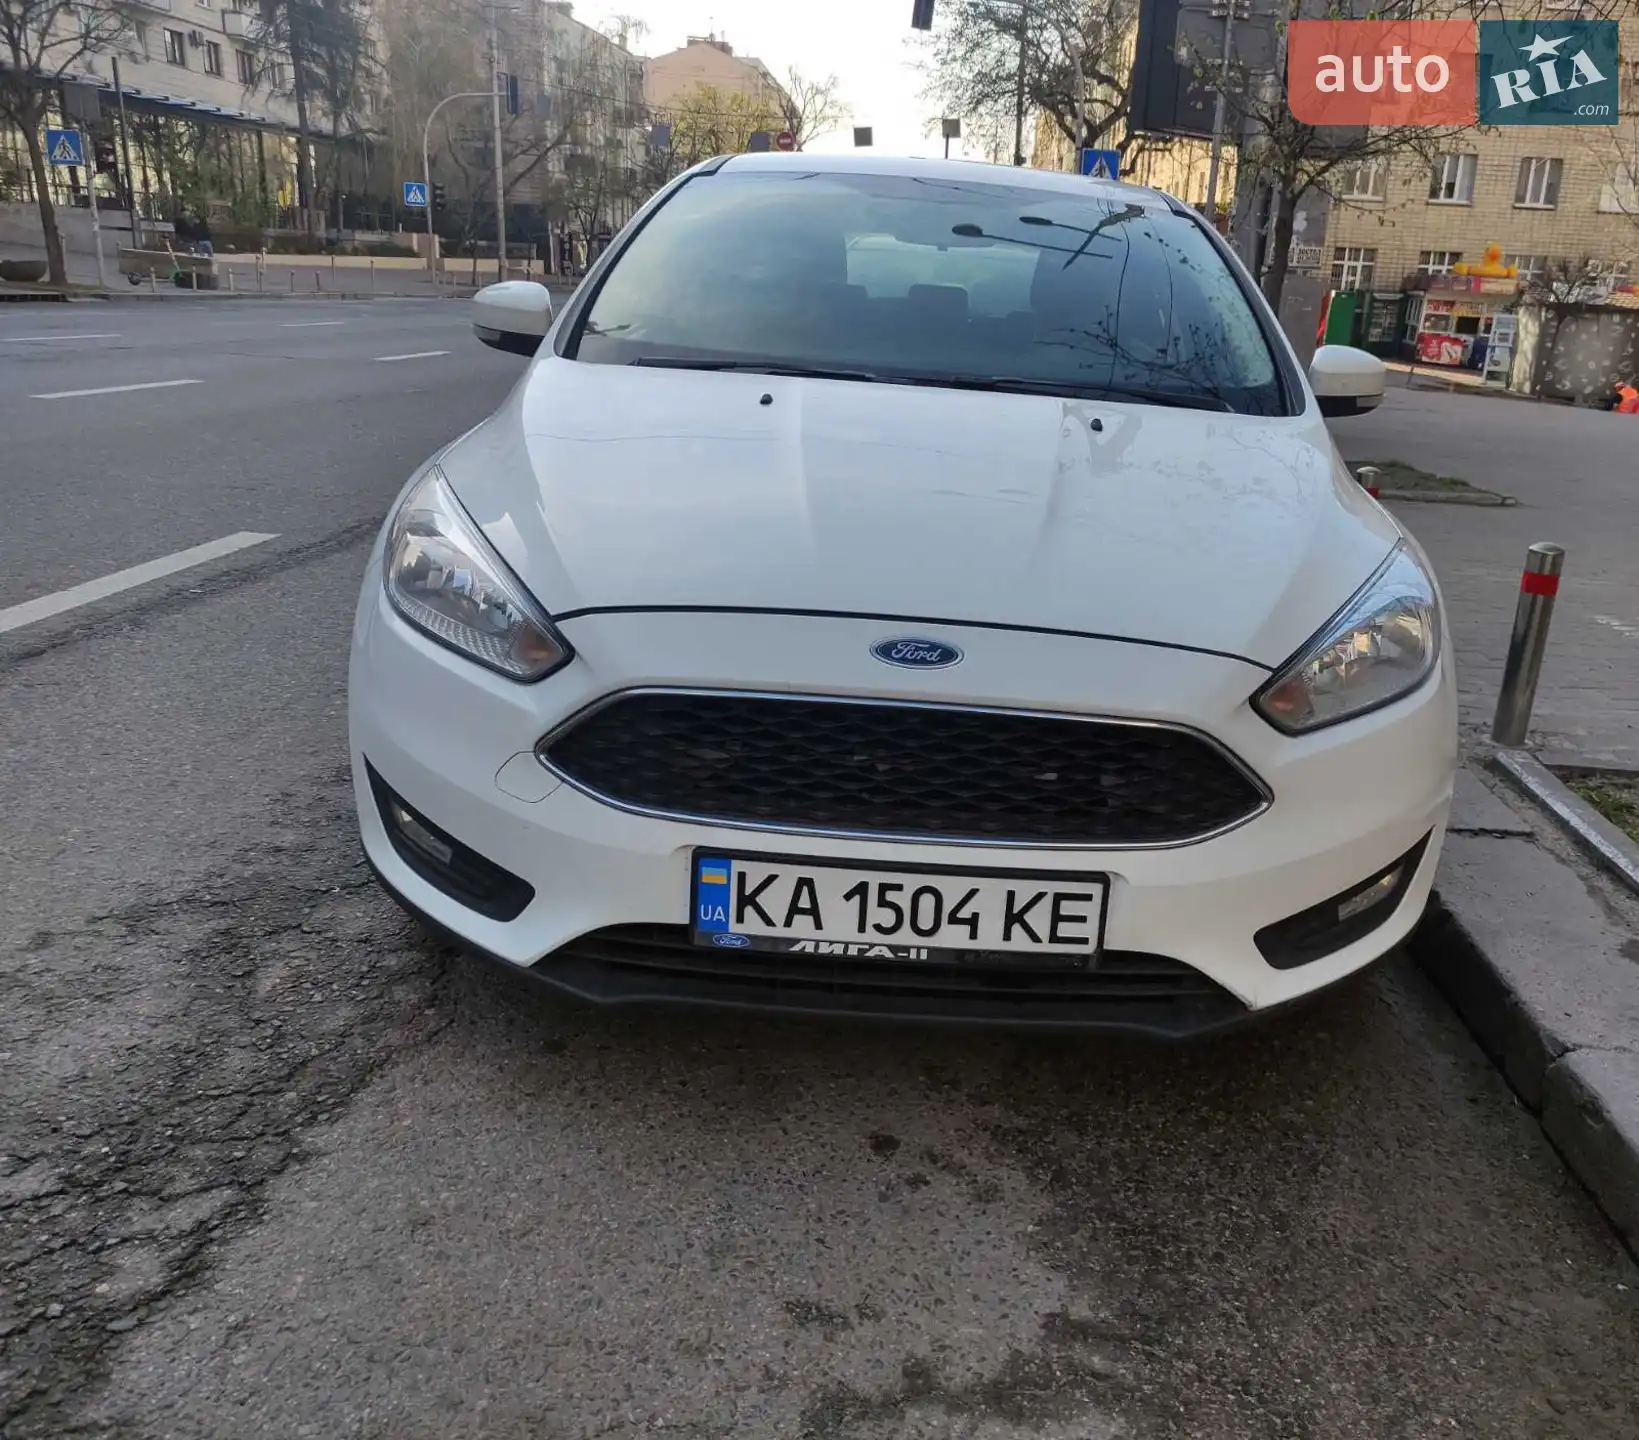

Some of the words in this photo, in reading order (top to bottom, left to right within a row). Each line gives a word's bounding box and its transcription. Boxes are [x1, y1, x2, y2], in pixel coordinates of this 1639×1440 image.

[891, 641, 942, 662] Ford
[700, 904, 727, 923] UA
[735, 870, 824, 931] KA
[842, 880, 981, 941] 1504
[1002, 889, 1094, 946] KE
[719, 934, 744, 947] Ford
